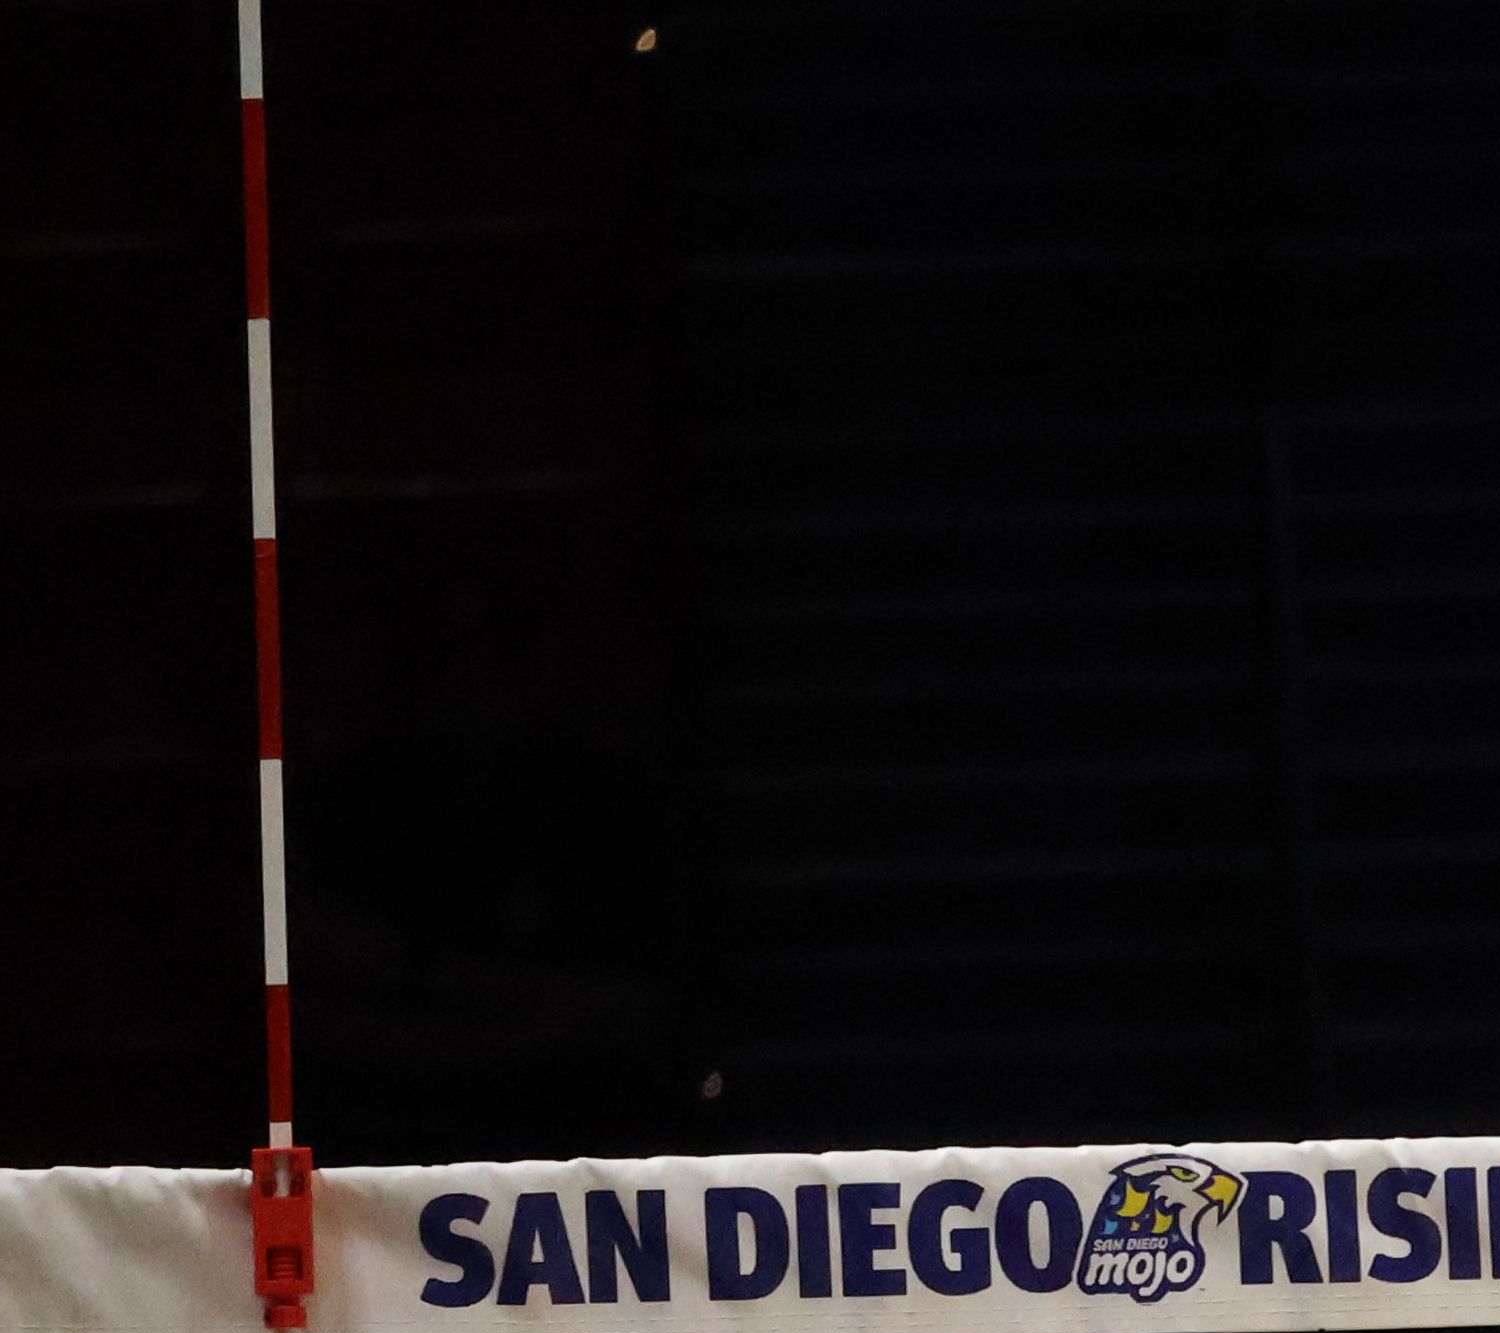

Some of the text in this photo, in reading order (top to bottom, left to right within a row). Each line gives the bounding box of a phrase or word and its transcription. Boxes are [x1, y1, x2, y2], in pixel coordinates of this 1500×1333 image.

[415, 1188, 671, 1308] SAN
[704, 1176, 1084, 1302] DIEGO
[1093, 1236, 1169, 1252] SAN DIEGO
[1084, 1249, 1196, 1297] mojo
